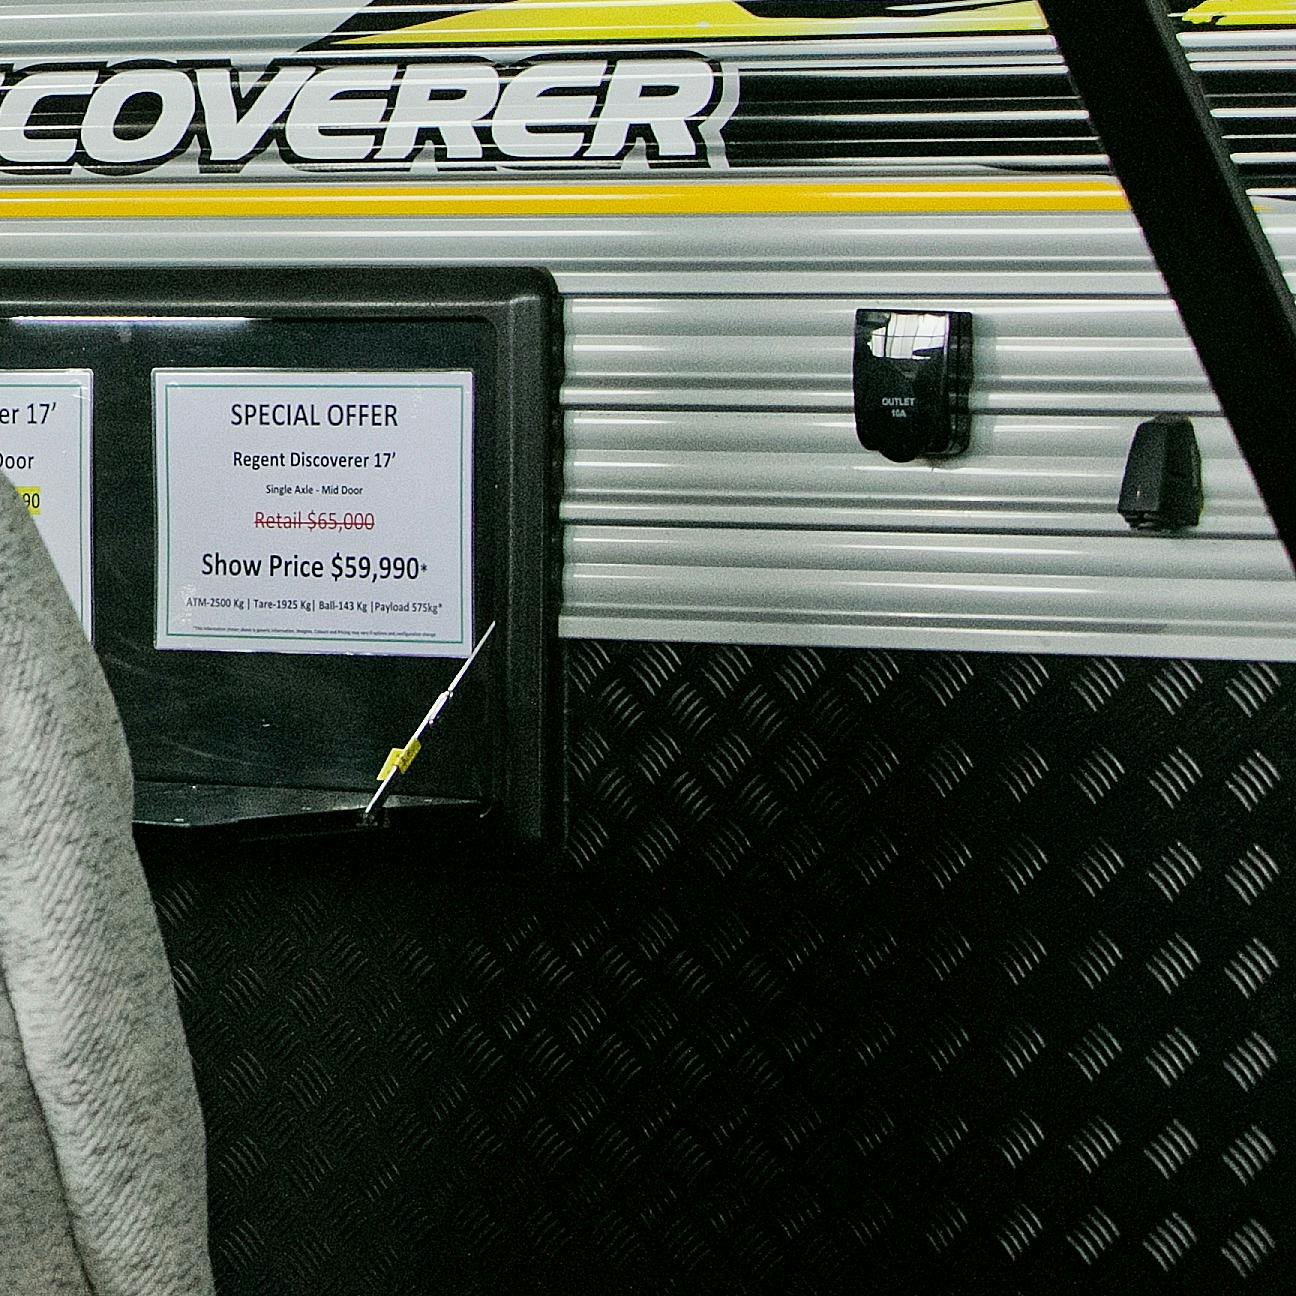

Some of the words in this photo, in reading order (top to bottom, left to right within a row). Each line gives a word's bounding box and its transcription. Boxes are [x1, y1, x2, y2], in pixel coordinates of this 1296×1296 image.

[881, 397, 916, 406] OUTLET
[230, 403, 321, 427] SPECIAL
[327, 404, 399, 427] OFFER
[233, 451, 286, 471] Regent
[290, 451, 370, 468] Discoverer
[265, 484, 292, 496] Single
[294, 484, 314, 495] Axle
[321, 485, 339, 495] Mid
[341, 485, 364, 496] Door
[22, 492, 40, 509] 90
[254, 511, 302, 529] Retail
[307, 510, 376, 533] $65,000
[201, 552, 262, 577] Show
[269, 554, 324, 578] Price
[186, 597, 232, 608] ATM-2500
[233, 597, 244, 610] Kg
[254, 599, 298, 610] Tare-1925
[318, 600, 355, 611] Ball-143
